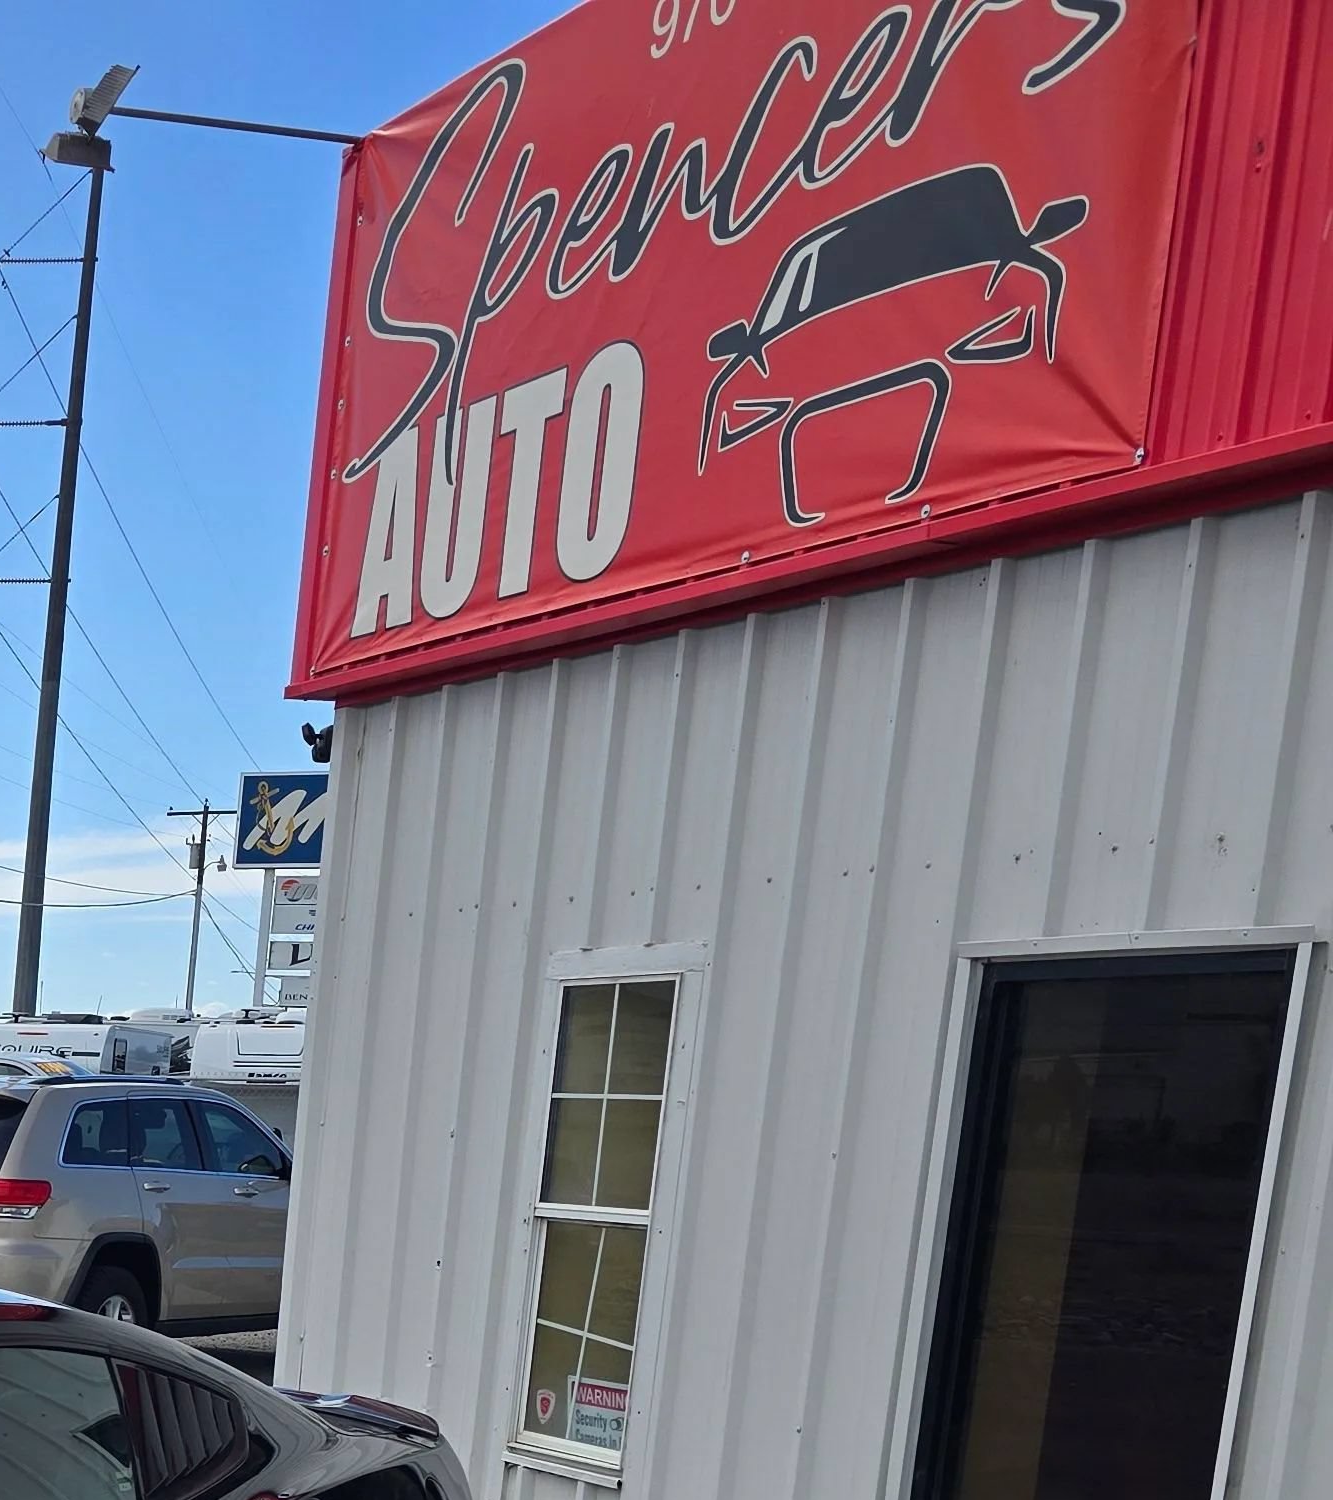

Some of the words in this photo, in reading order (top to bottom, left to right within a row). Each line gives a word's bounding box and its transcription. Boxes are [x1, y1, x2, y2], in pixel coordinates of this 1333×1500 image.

[349, 340, 646, 640] AUTO
[577, 1386, 628, 1409] WARNIN
[575, 1409, 607, 1432] Security
